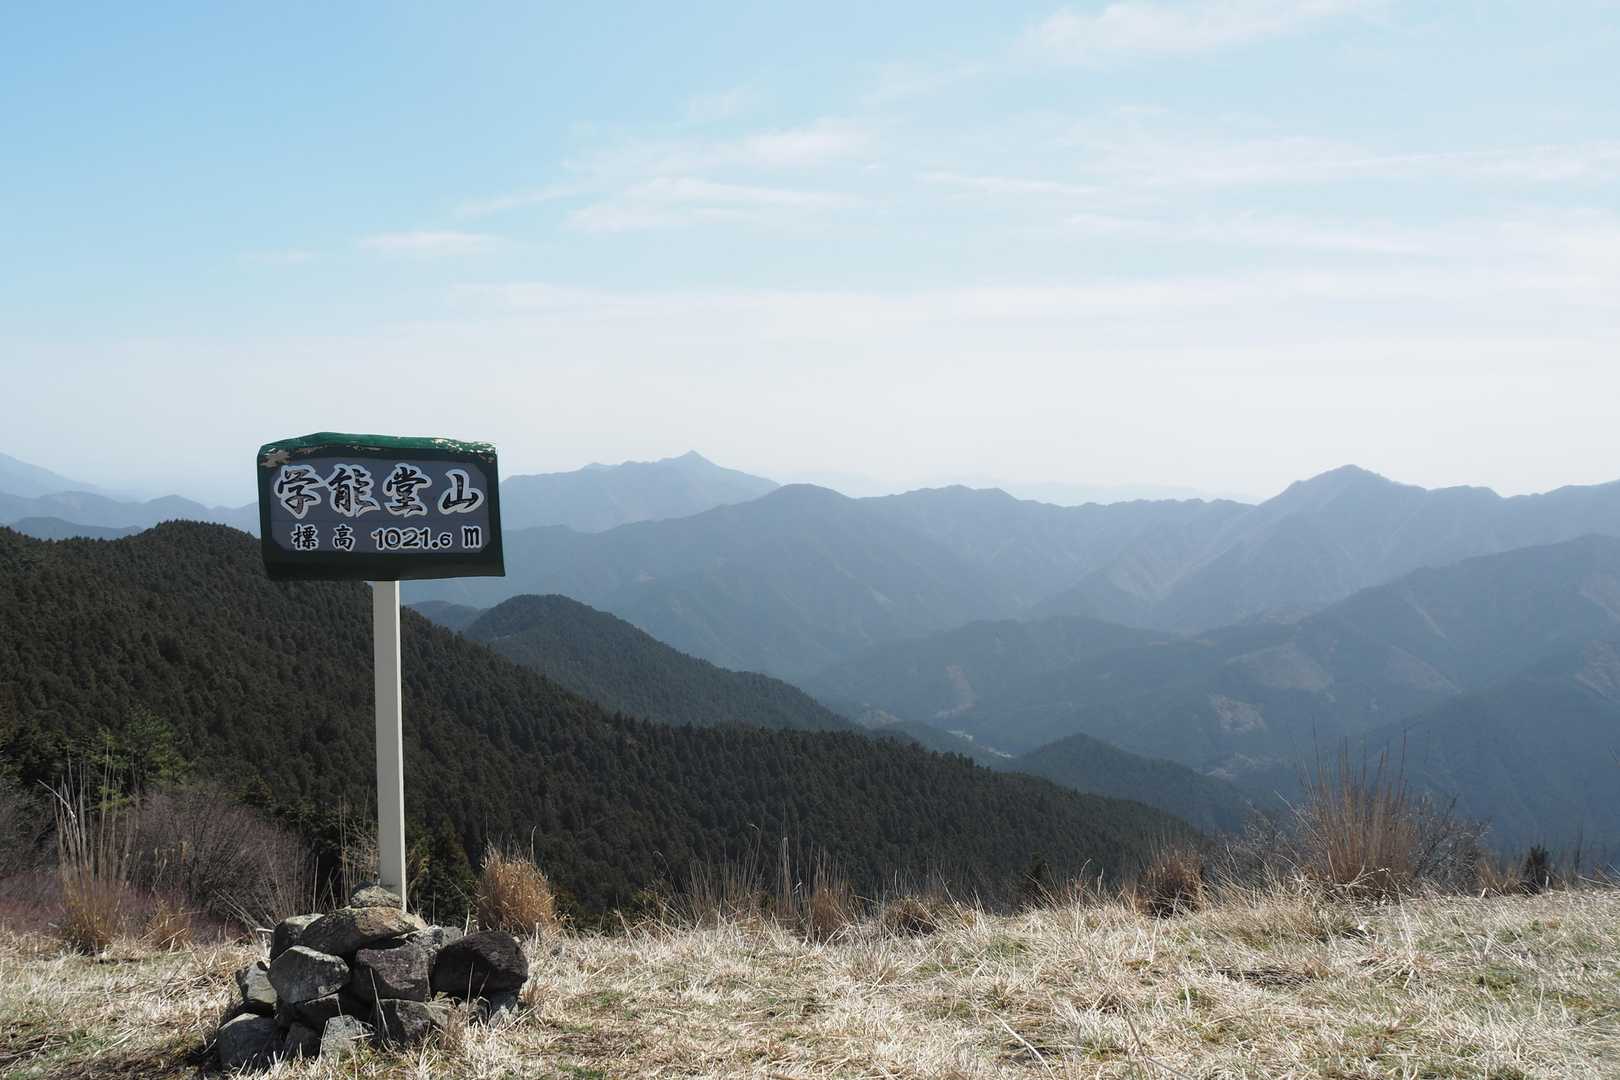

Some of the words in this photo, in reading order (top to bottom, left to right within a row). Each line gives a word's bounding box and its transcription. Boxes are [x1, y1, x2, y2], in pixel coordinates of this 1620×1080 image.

[275, 464, 484, 518] 学能堂山
[292, 525, 354, 550] 標高
[372, 528, 451, 549] 1021.6
[463, 526, 481, 548] m
